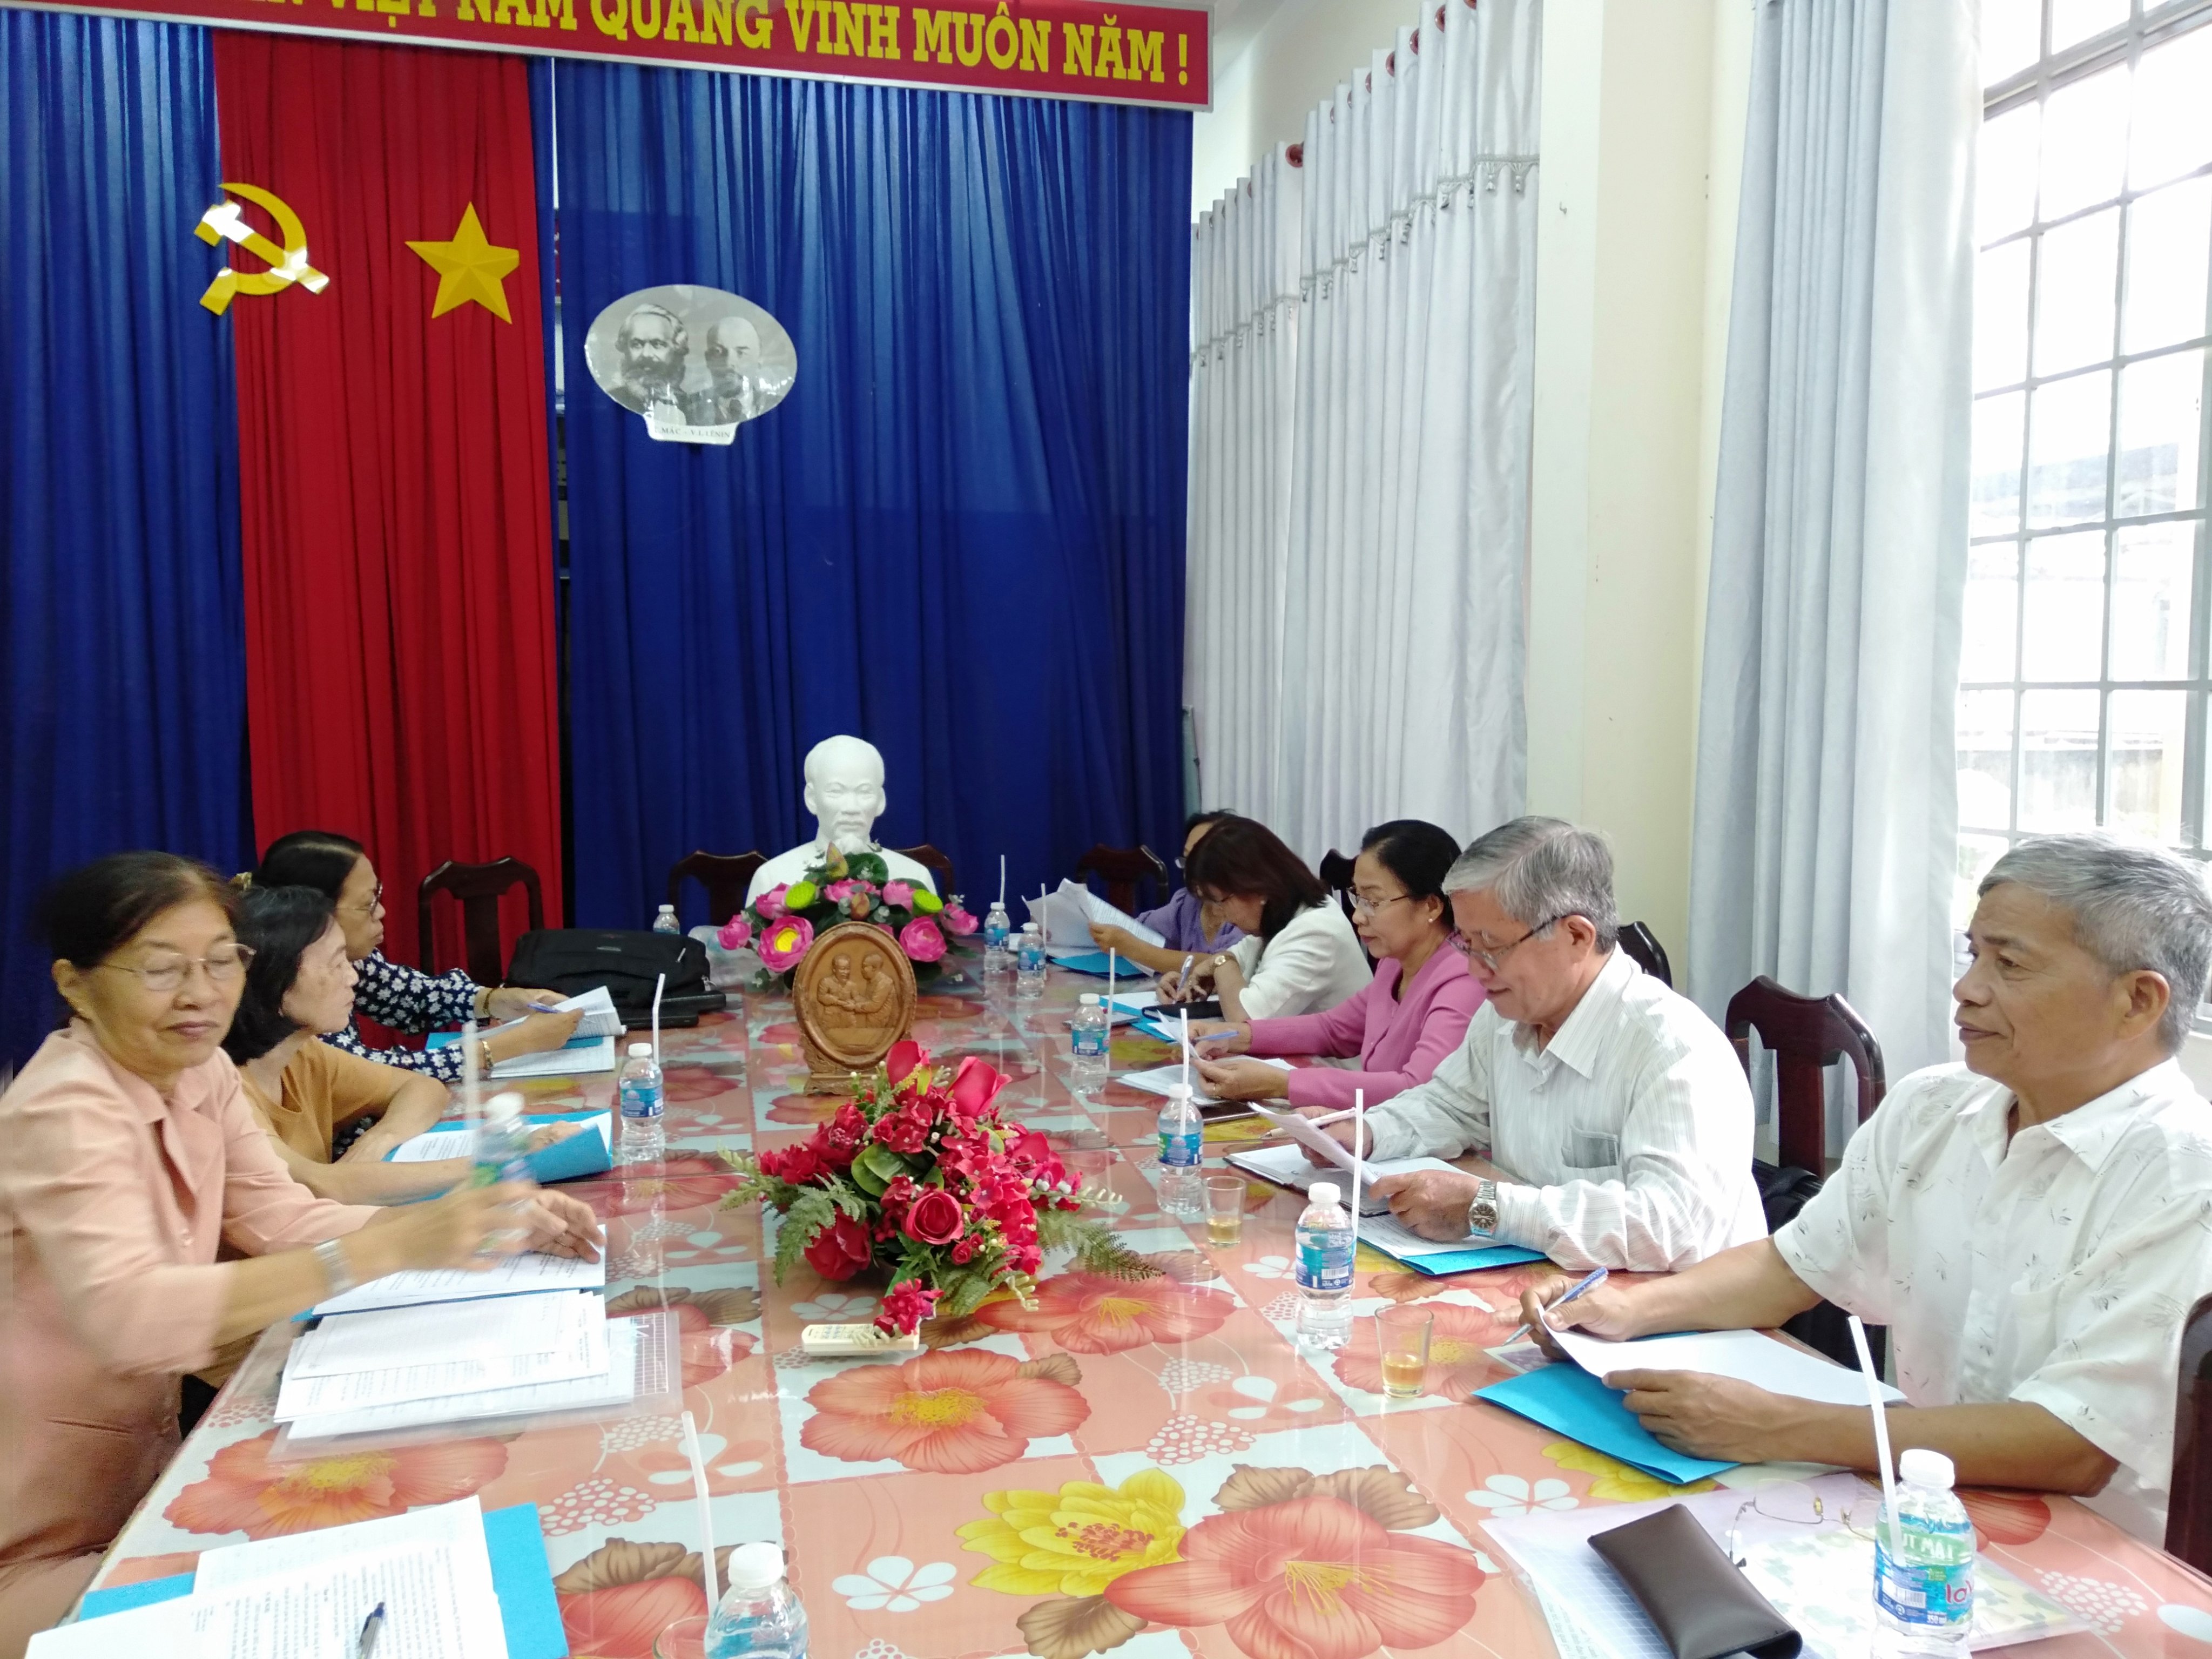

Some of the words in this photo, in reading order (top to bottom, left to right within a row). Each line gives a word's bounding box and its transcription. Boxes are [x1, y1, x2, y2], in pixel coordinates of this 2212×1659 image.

[590, 0, 773, 49] QUANG
[784, 0, 901, 60] VINH
[913, 2, 1051, 72] MUÔN
[1063, 14, 1164, 83] NĂM
